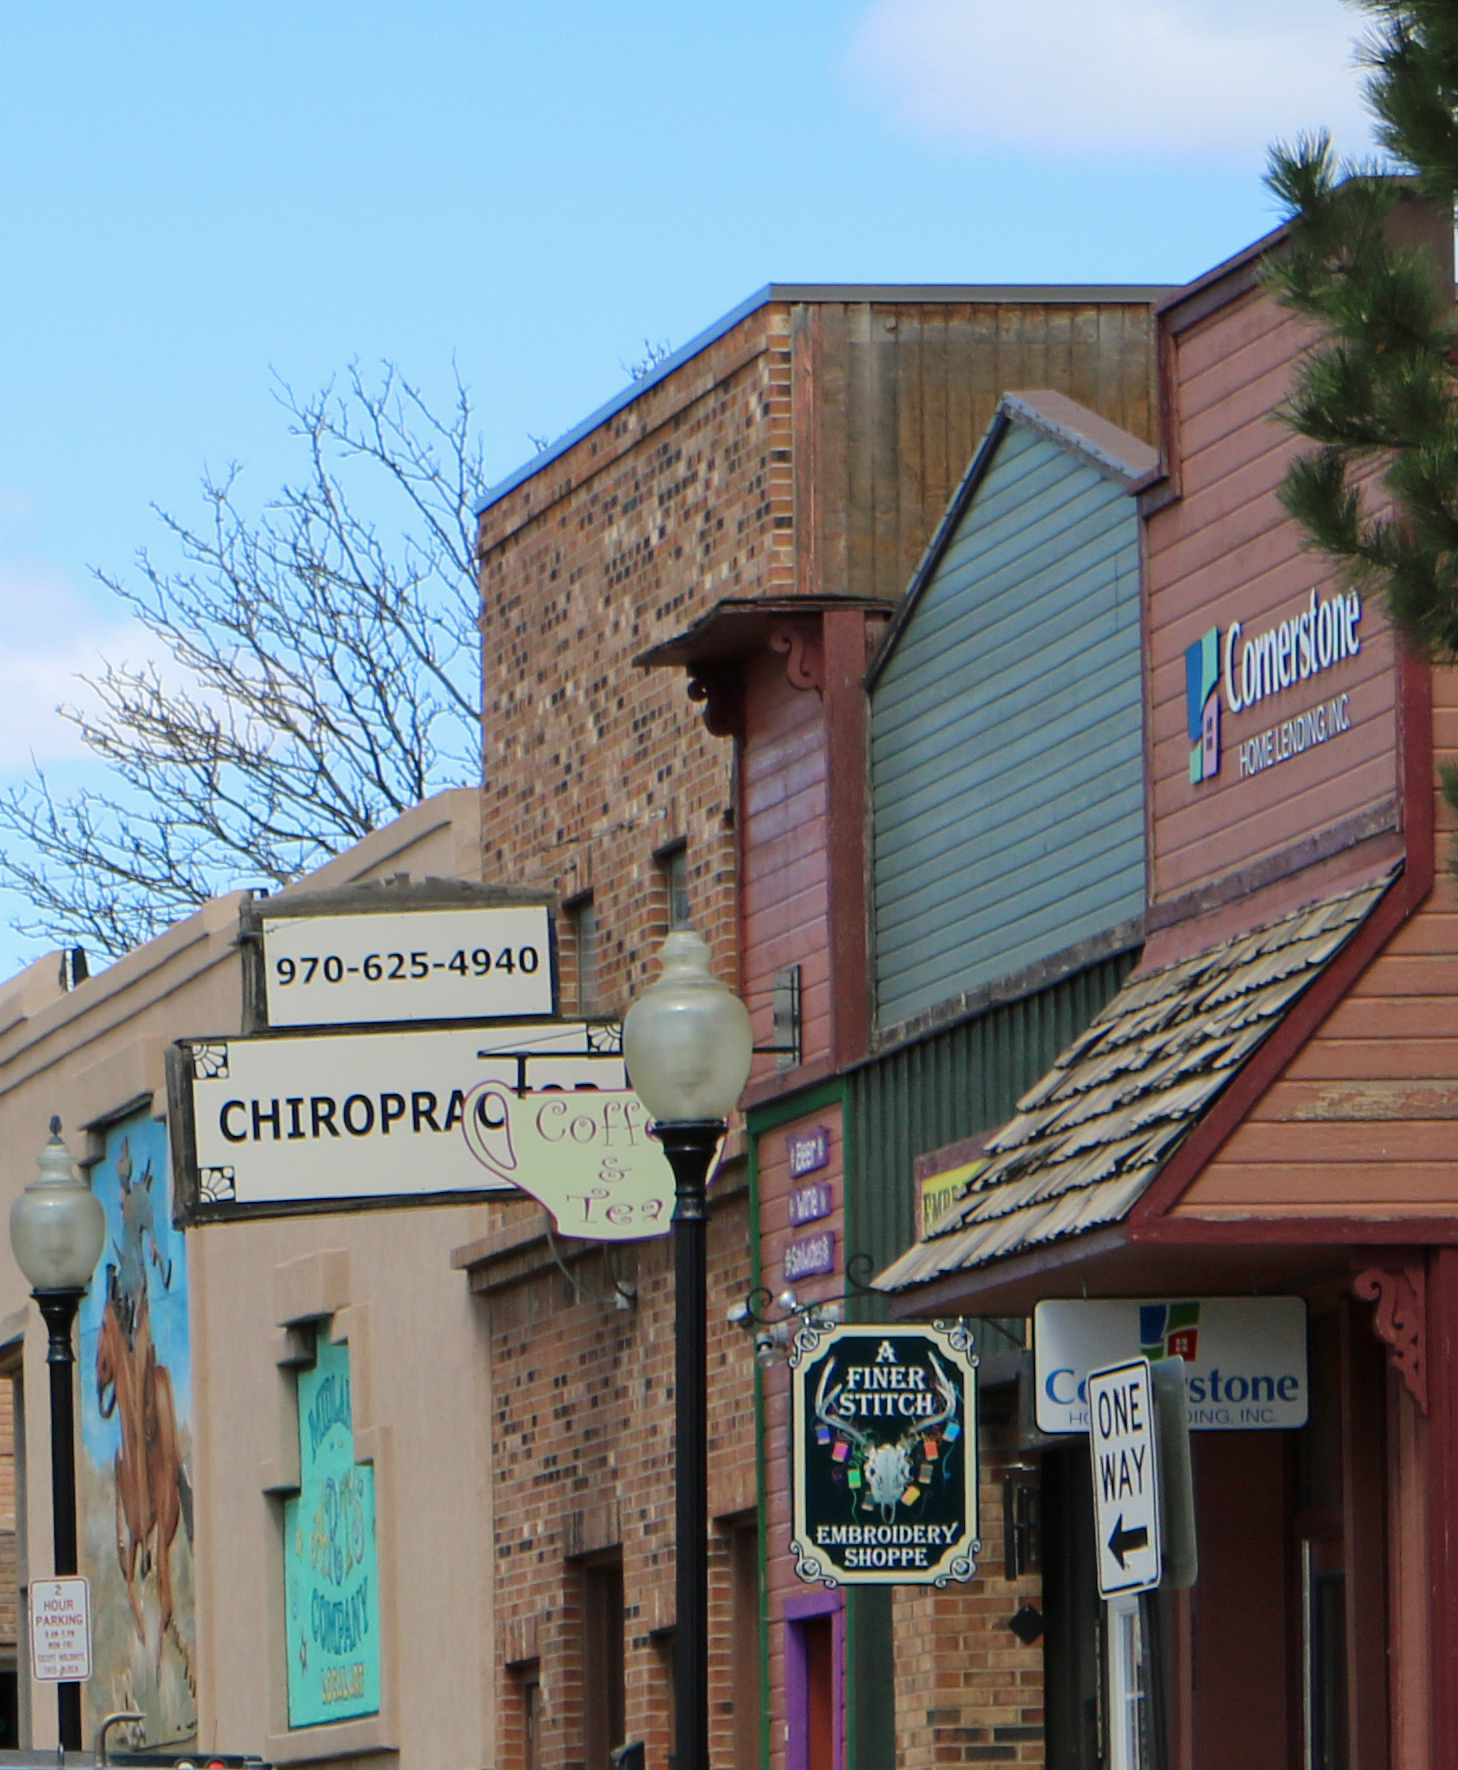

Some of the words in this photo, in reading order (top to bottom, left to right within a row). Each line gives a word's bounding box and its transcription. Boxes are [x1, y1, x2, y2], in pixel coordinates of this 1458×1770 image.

[1225, 587, 1362, 713] Cornerstone
[1240, 731, 1273, 778] HOME
[276, 945, 540, 986] 970-625-4940
[219, 1083, 599, 1144] CHIROPRAC
[535, 1100, 662, 1147] Coff
[599, 1158, 632, 1184] &
[566, 1188, 663, 1226] Tea
[876, 1340, 896, 1364] A
[847, 1366, 926, 1390] FINER
[1045, 1368, 1300, 1404] Cstone
[838, 1393, 936, 1418] STITCH
[1098, 1382, 1143, 1440] ONE
[1240, 1409, 1274, 1424] INC
[1099, 1445, 1146, 1503] WAY
[815, 1521, 960, 1546] EMBROIDERY
[843, 1547, 928, 1568] SHOPPE
[55, 1584, 63, 1596] 2
[44, 1600, 74, 1612] HOUR
[36, 1614, 84, 1627] PARKING
